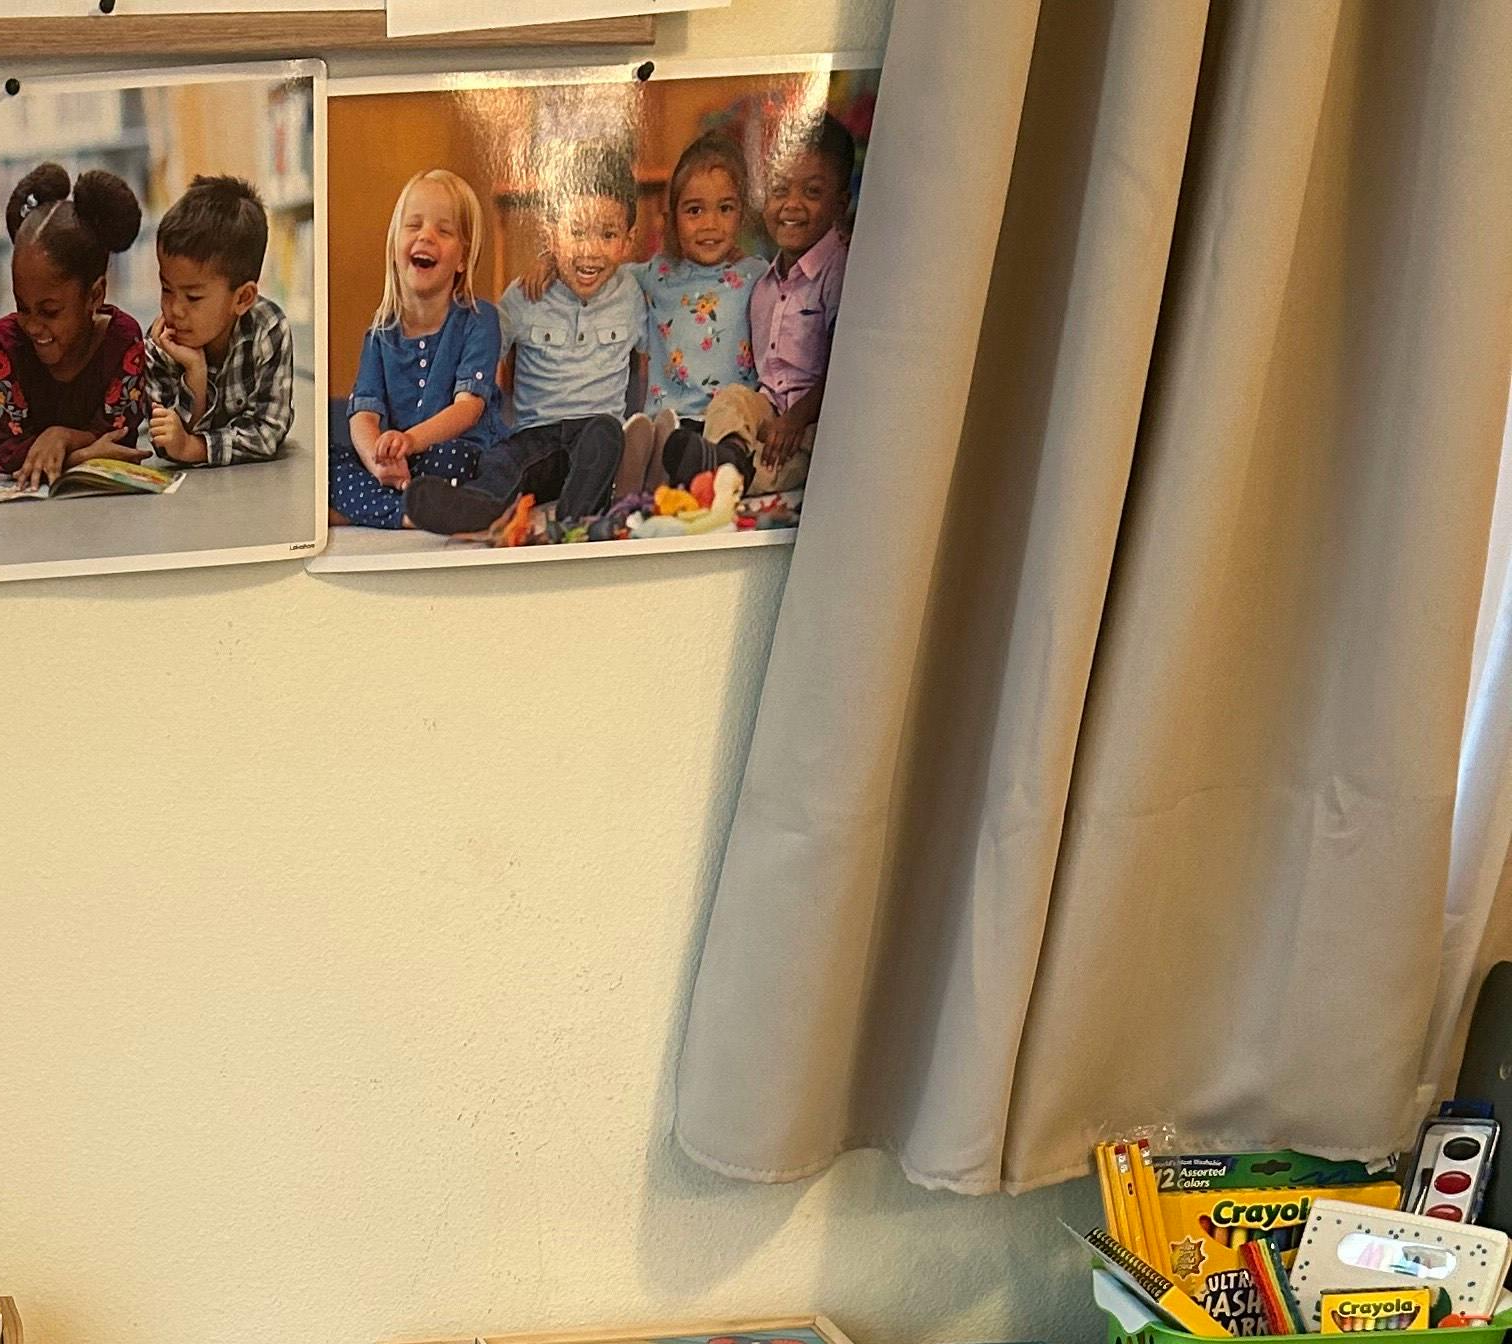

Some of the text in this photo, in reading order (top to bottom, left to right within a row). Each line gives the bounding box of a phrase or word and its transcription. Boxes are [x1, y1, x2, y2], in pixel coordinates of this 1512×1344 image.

[1180, 1166, 1227, 1178] Assorted
[1177, 1178, 1210, 1188] Colors
[1212, 1198, 1310, 1228] Crayol
[1338, 1299, 1415, 1317] Crayola
